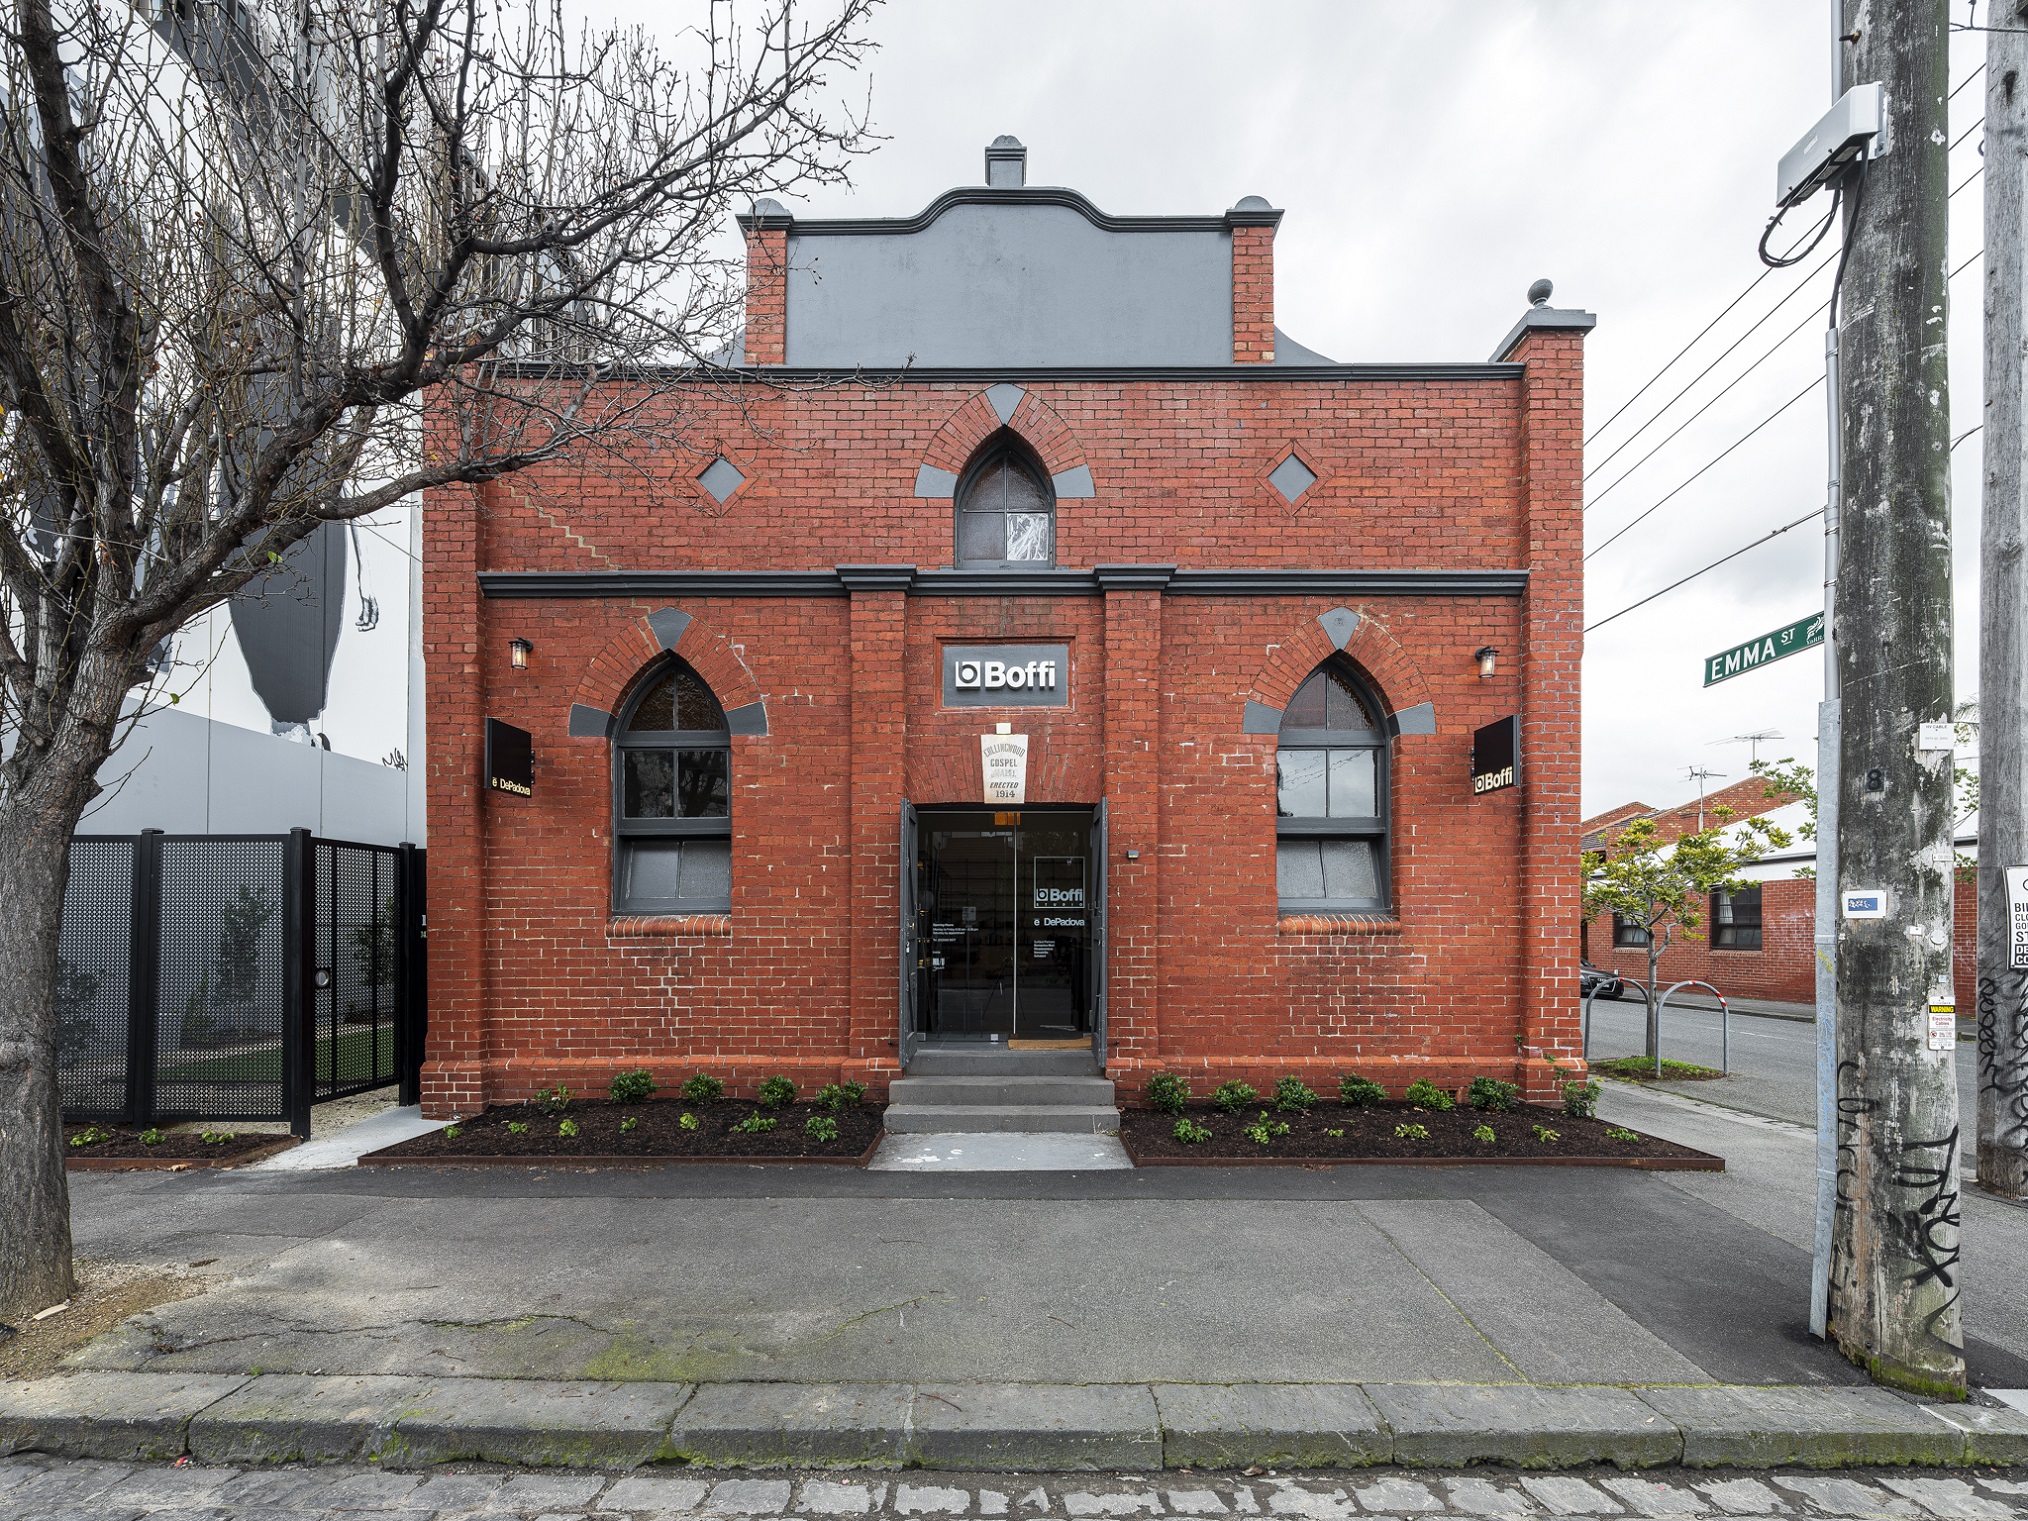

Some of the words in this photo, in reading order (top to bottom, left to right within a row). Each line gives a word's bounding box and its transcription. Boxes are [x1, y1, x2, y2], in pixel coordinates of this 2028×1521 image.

[1711, 637, 1776, 681] EMMA
[1781, 628, 1795, 644] ST
[985, 661, 1055, 688] Boffi
[1485, 766, 1513, 790] Boffi
[1867, 769, 1882, 790] 8
[500, 778, 531, 795] DePadova
[996, 790, 1015, 798] 1914
[1050, 888, 1083, 901] Boffi
[2014, 902, 2028, 913] BI
[1044, 917, 1085, 926] DePadova
[2015, 922, 2028, 930] GO
